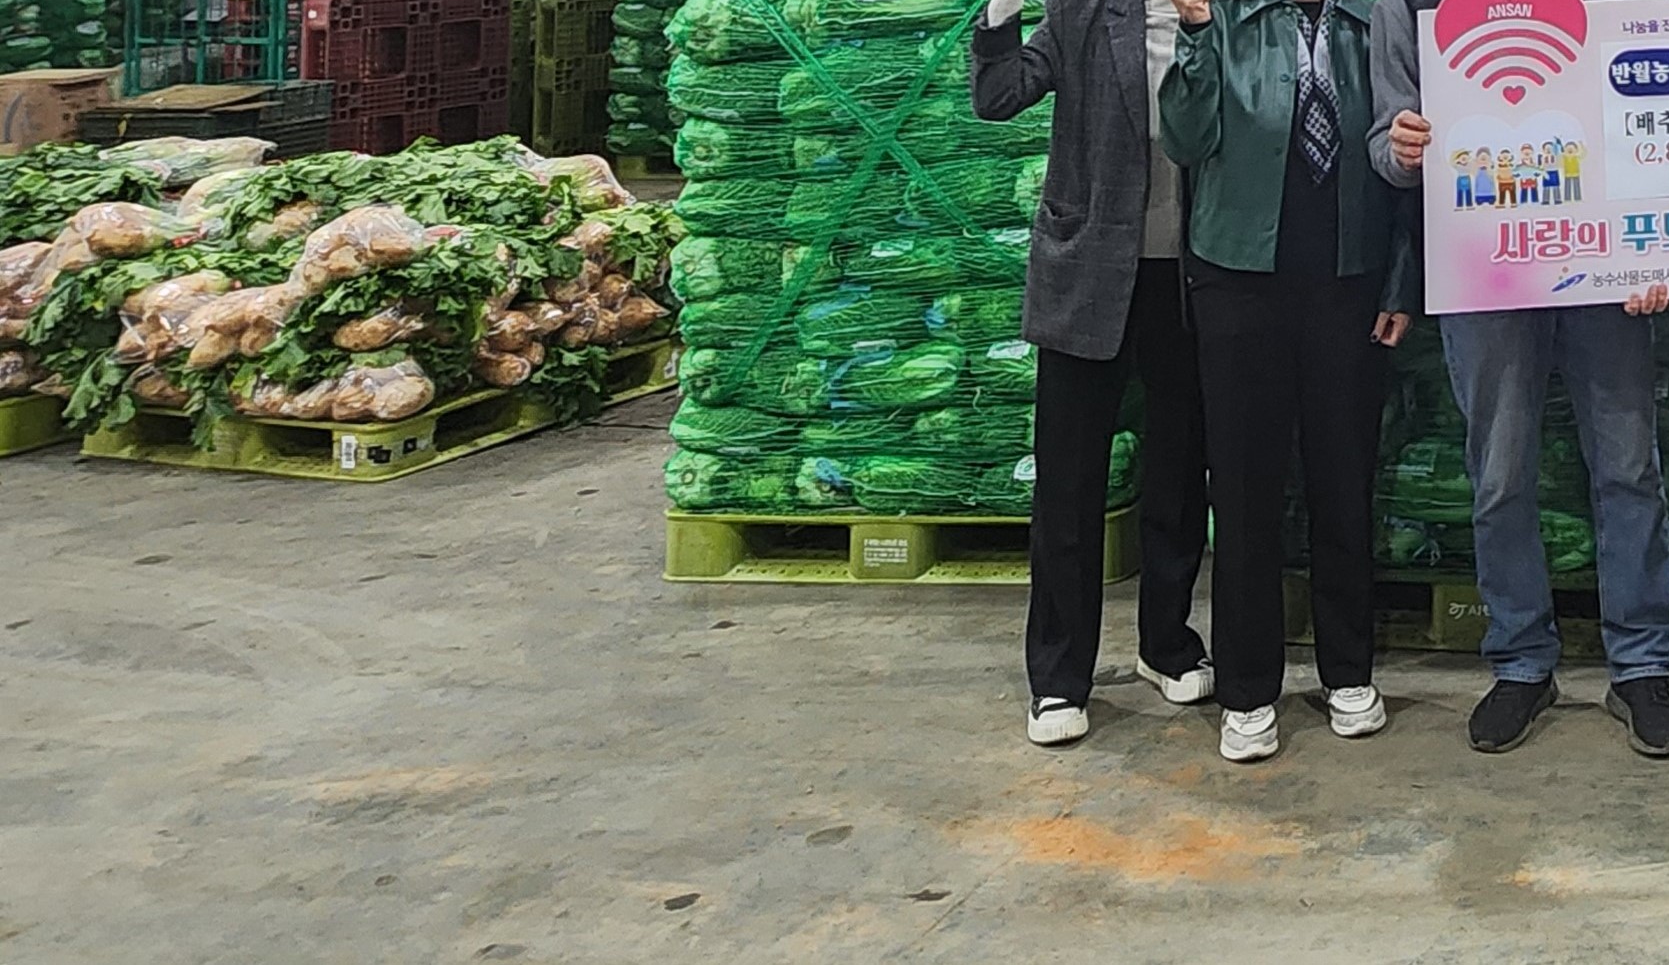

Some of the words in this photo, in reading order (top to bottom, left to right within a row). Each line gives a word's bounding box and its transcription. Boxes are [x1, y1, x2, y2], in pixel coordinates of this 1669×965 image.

[1487, 2, 1533, 20] ANSAN
[1622, 19, 1659, 34] 나눔을
[1492, 218, 1607, 260] 사랑의
